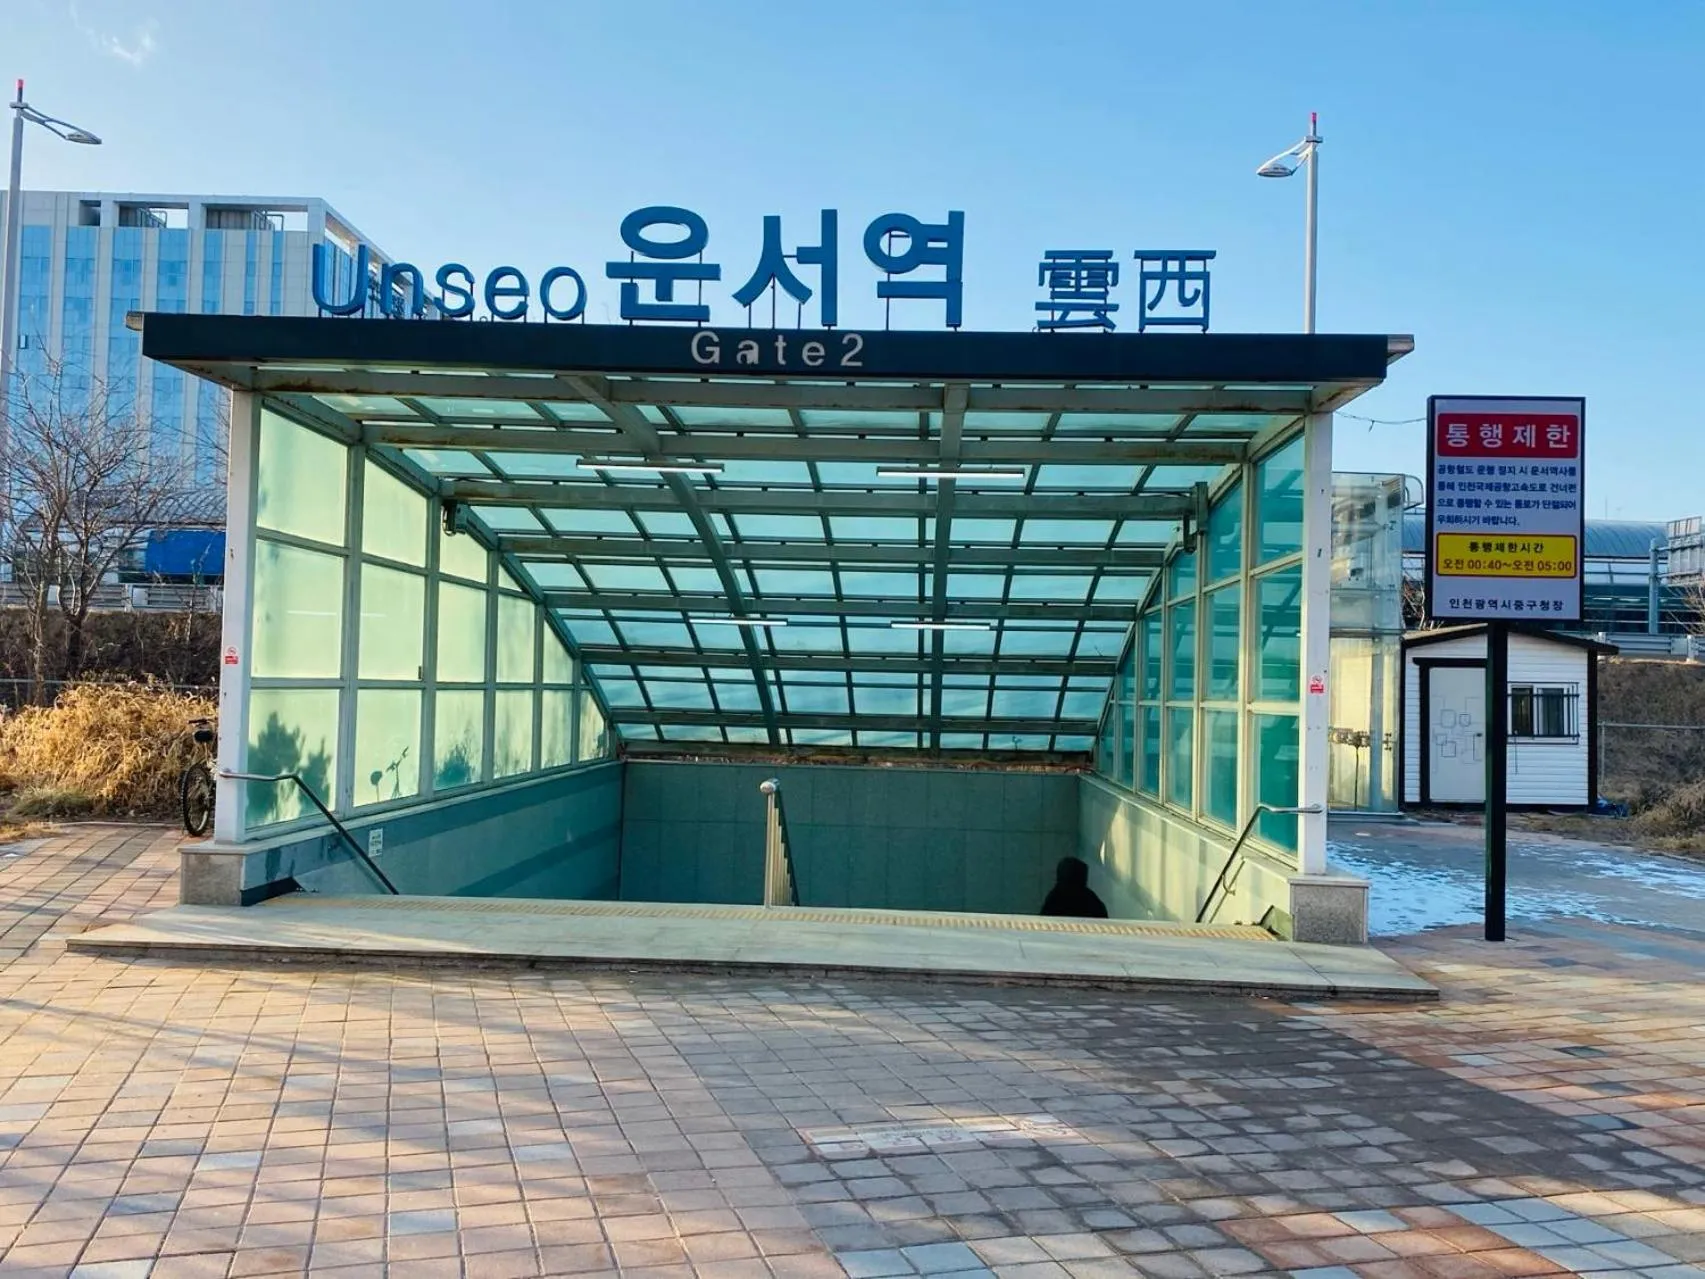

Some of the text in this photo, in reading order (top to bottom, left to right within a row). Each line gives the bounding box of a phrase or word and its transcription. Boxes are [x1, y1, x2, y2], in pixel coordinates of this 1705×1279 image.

[312, 205, 1216, 332] Unseo 운서역 雲西
[1438, 464, 1474, 475] 공항철도
[1519, 465, 1528, 475] 시
[1437, 498, 1454, 507] 으로
[1484, 498, 1493, 508] 수
[1443, 558, 1464, 570] 오전
[1537, 560, 1573, 571] 05:00
